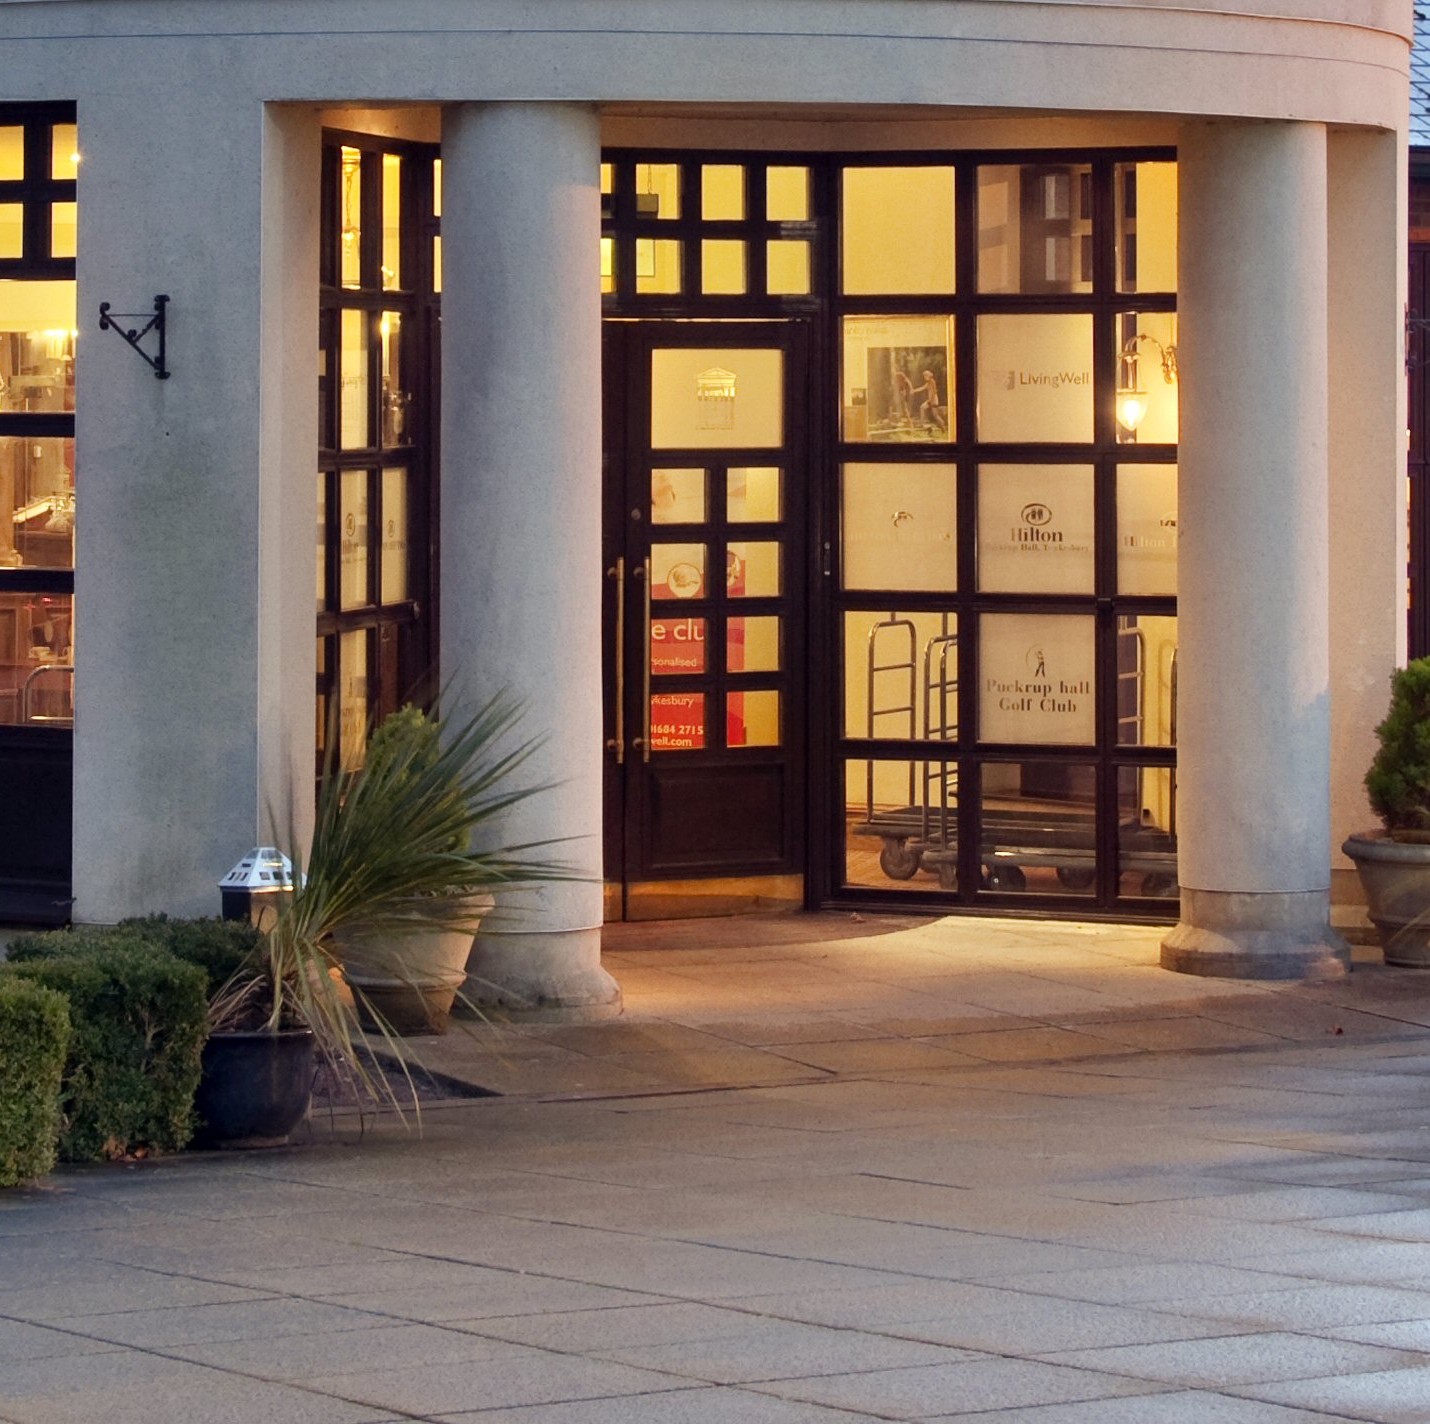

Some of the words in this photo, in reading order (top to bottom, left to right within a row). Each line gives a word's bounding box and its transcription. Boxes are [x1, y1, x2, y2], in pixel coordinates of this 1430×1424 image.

[1019, 371, 1090, 389] LivingWell
[1010, 526, 1063, 543] Hilton
[986, 678, 1052, 697] Puckrup
[998, 697, 1033, 712] Golf
[1039, 698, 1077, 713] Club
